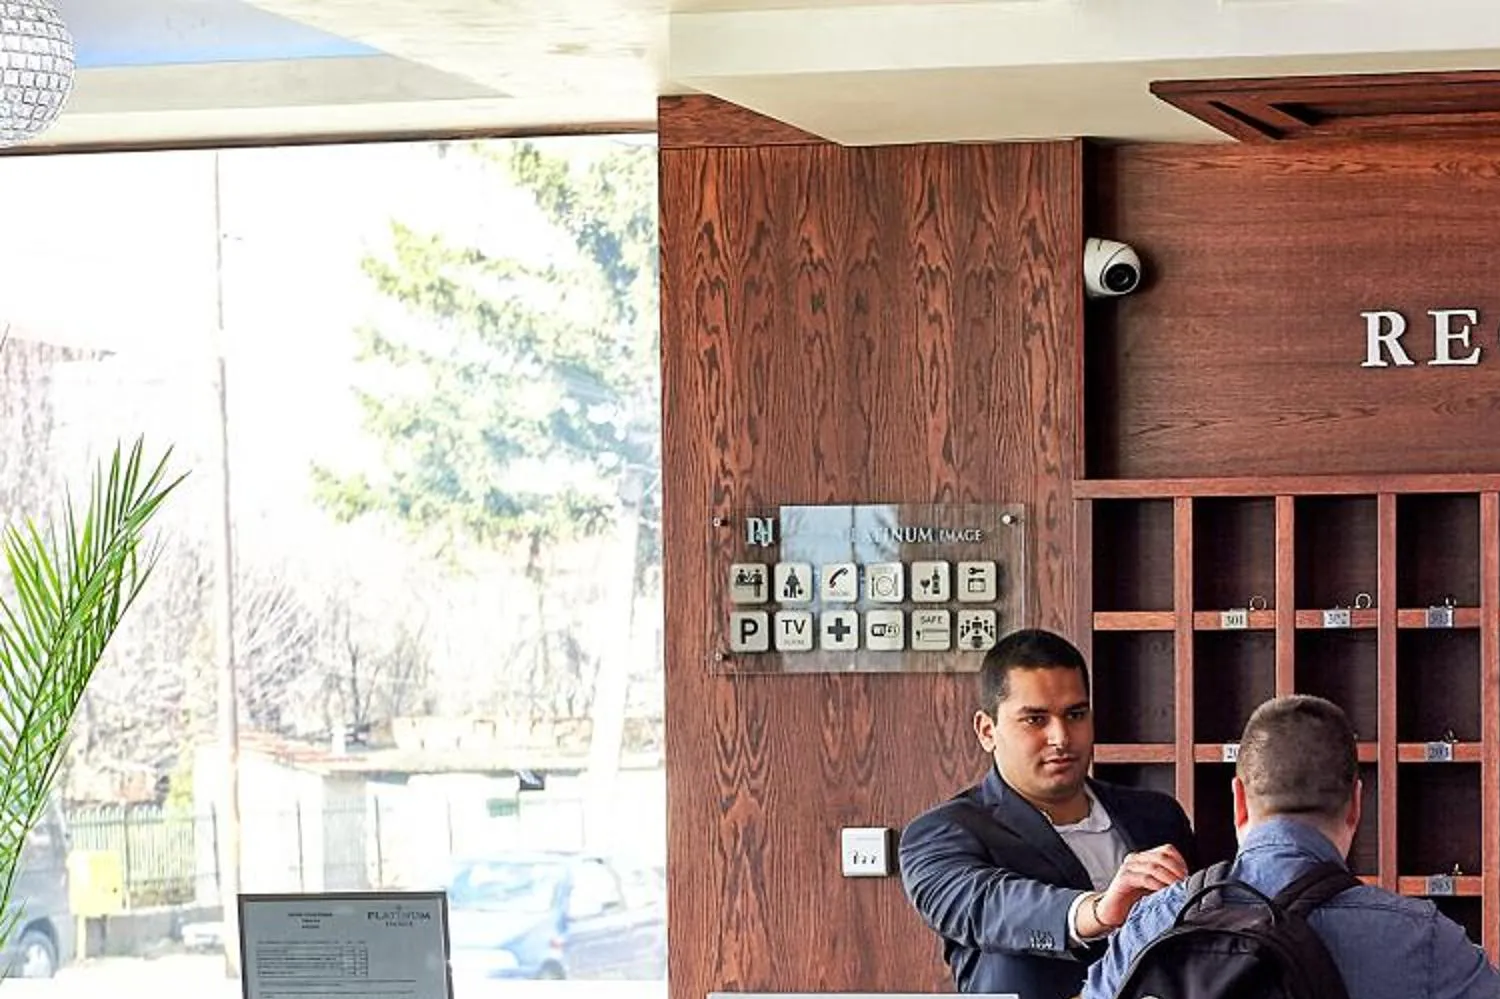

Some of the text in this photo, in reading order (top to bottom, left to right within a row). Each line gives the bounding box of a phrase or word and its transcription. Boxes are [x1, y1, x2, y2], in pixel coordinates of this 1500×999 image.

[939, 528, 983, 543] IMAGE
[781, 619, 806, 635] TV
[920, 615, 944, 625] SAFE
